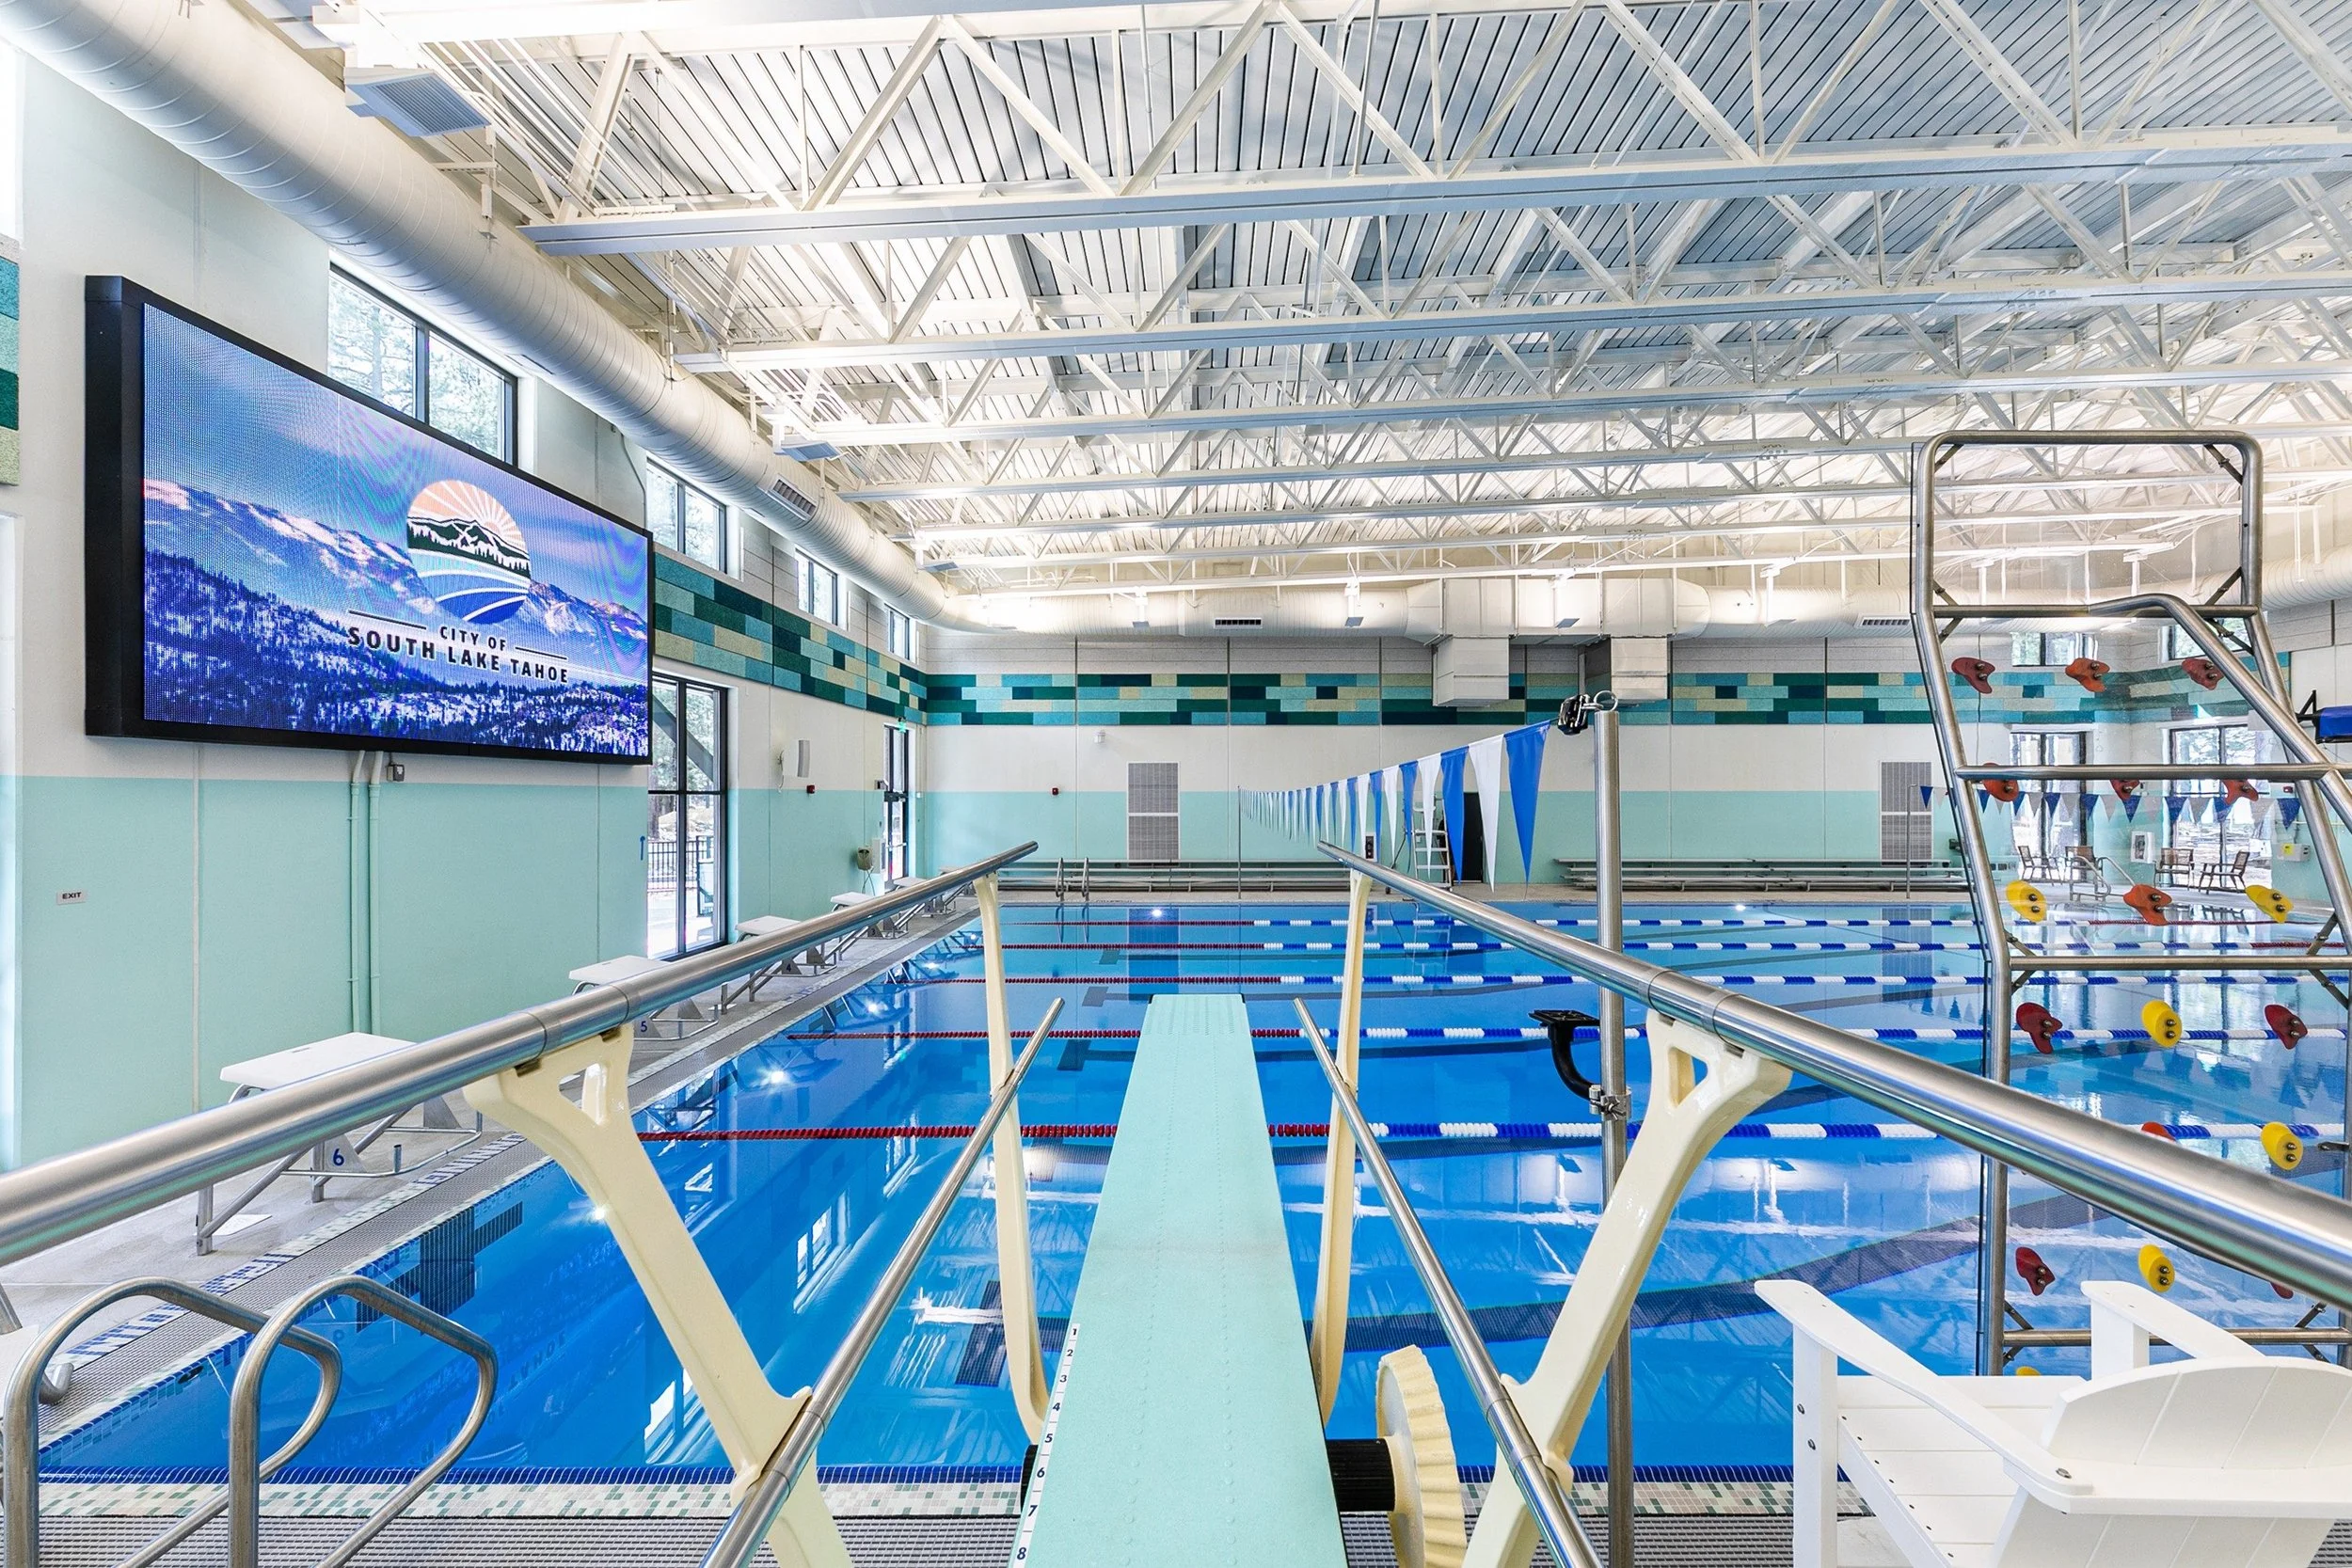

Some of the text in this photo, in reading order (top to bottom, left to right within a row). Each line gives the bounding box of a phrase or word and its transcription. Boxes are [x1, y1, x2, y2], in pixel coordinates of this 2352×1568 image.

[439, 626, 507, 652] CITY OF
[348, 626, 568, 683] SOUTH LAKE TAHOE
[62, 892, 82, 900] EXIT
[870, 927, 876, 936] 3
[786, 963, 792, 973] 4
[640, 1021, 648, 1033] 5
[332, 1148, 344, 1166] 6
[1072, 1328, 1077, 1337] 1
[1066, 1349, 1073, 1357] 2
[1059, 1374, 1068, 1383] 3
[1053, 1402, 1060, 1411] 4
[1044, 1433, 1054, 1443] 5
[1037, 1467, 1045, 1478] 6
[1028, 1505, 1038, 1516] 7
[1017, 1547, 1026, 1560] 8
